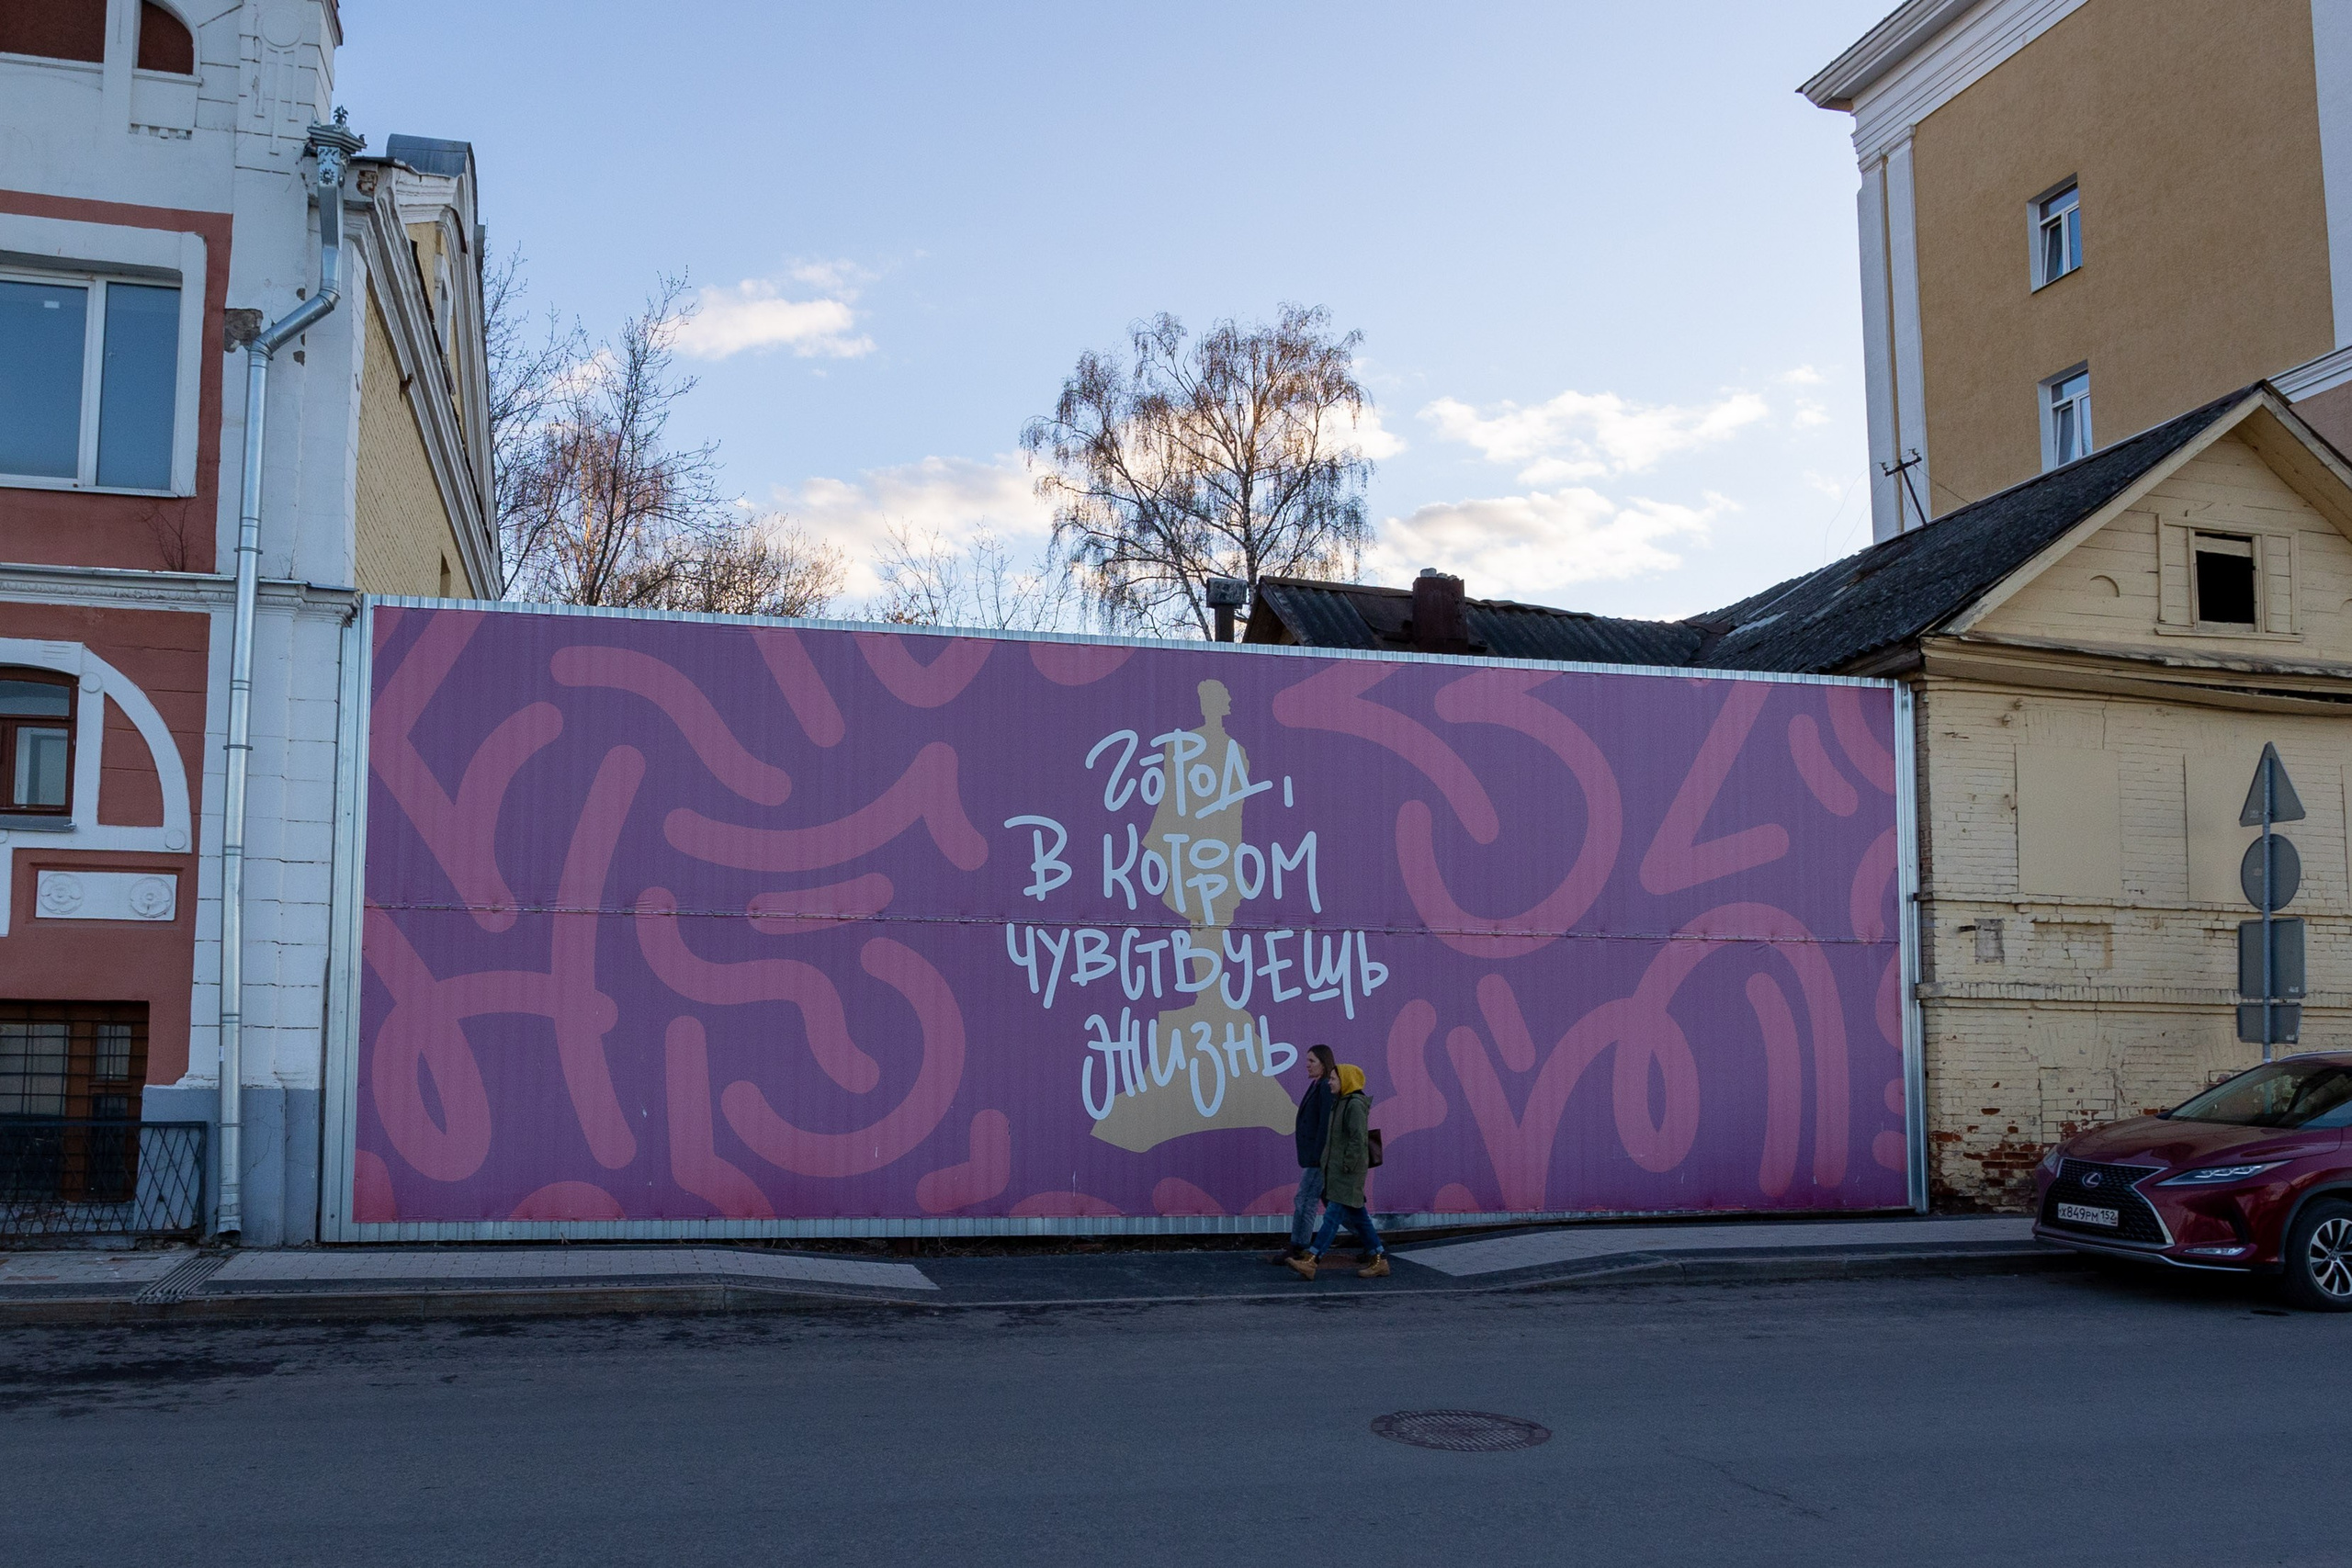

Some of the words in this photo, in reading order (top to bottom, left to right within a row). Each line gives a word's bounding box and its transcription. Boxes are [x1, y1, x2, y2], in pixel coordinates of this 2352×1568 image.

[1003, 814, 1073, 902] В
[1102, 822, 1323, 926] КОТОРОМ
[1080, 1006, 1299, 1121] ЖИЗНЬ
